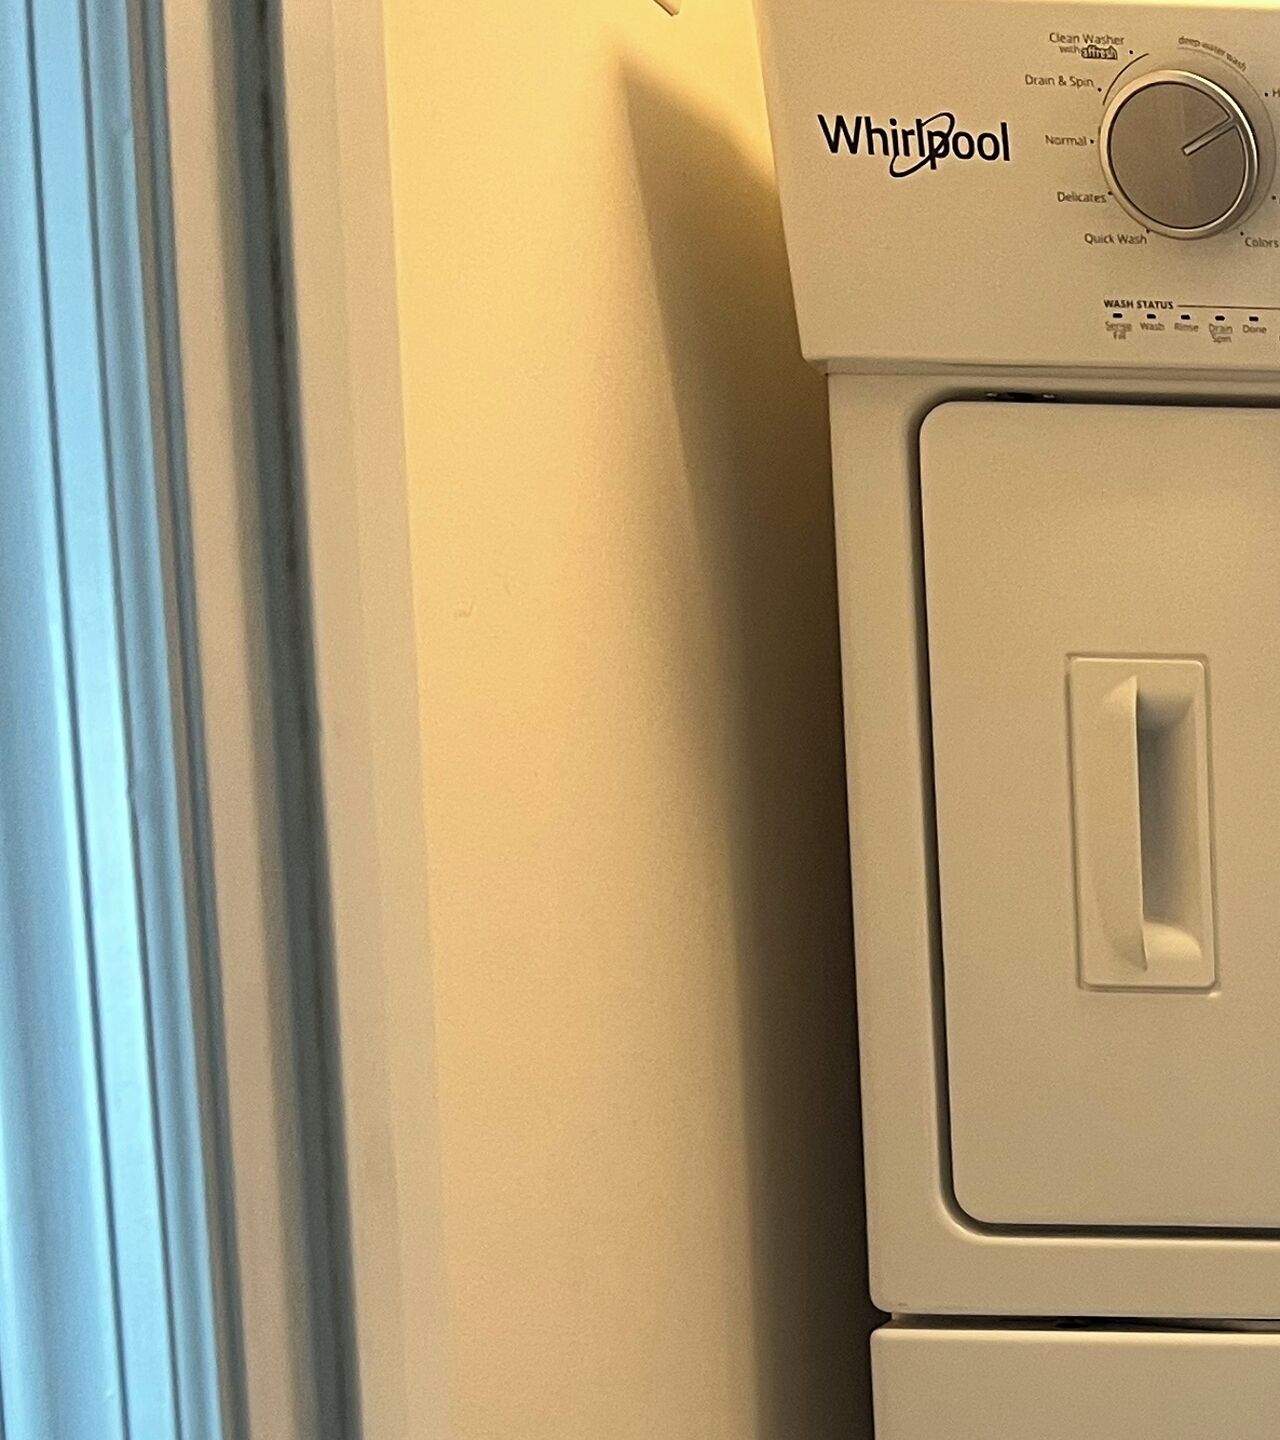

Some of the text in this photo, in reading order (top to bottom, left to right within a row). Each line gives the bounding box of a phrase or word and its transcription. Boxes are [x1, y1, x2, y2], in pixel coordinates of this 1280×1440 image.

[1049, 32, 1125, 45] Clean Washer
[1081, 45, 1118, 60] affresh
[1025, 74, 1095, 89] Drain & Spin
[817, 112, 1010, 178] Whirlpool
[1045, 135, 1087, 146] Normal
[1057, 191, 1107, 203] Delicates
[1084, 233, 1147, 246] Quick Wash
[1245, 237, 1279, 248] Colors
[1104, 300, 1174, 310] WASH STATUS
[1140, 322, 1166, 332] Wash
[1243, 324, 1268, 335] Done
